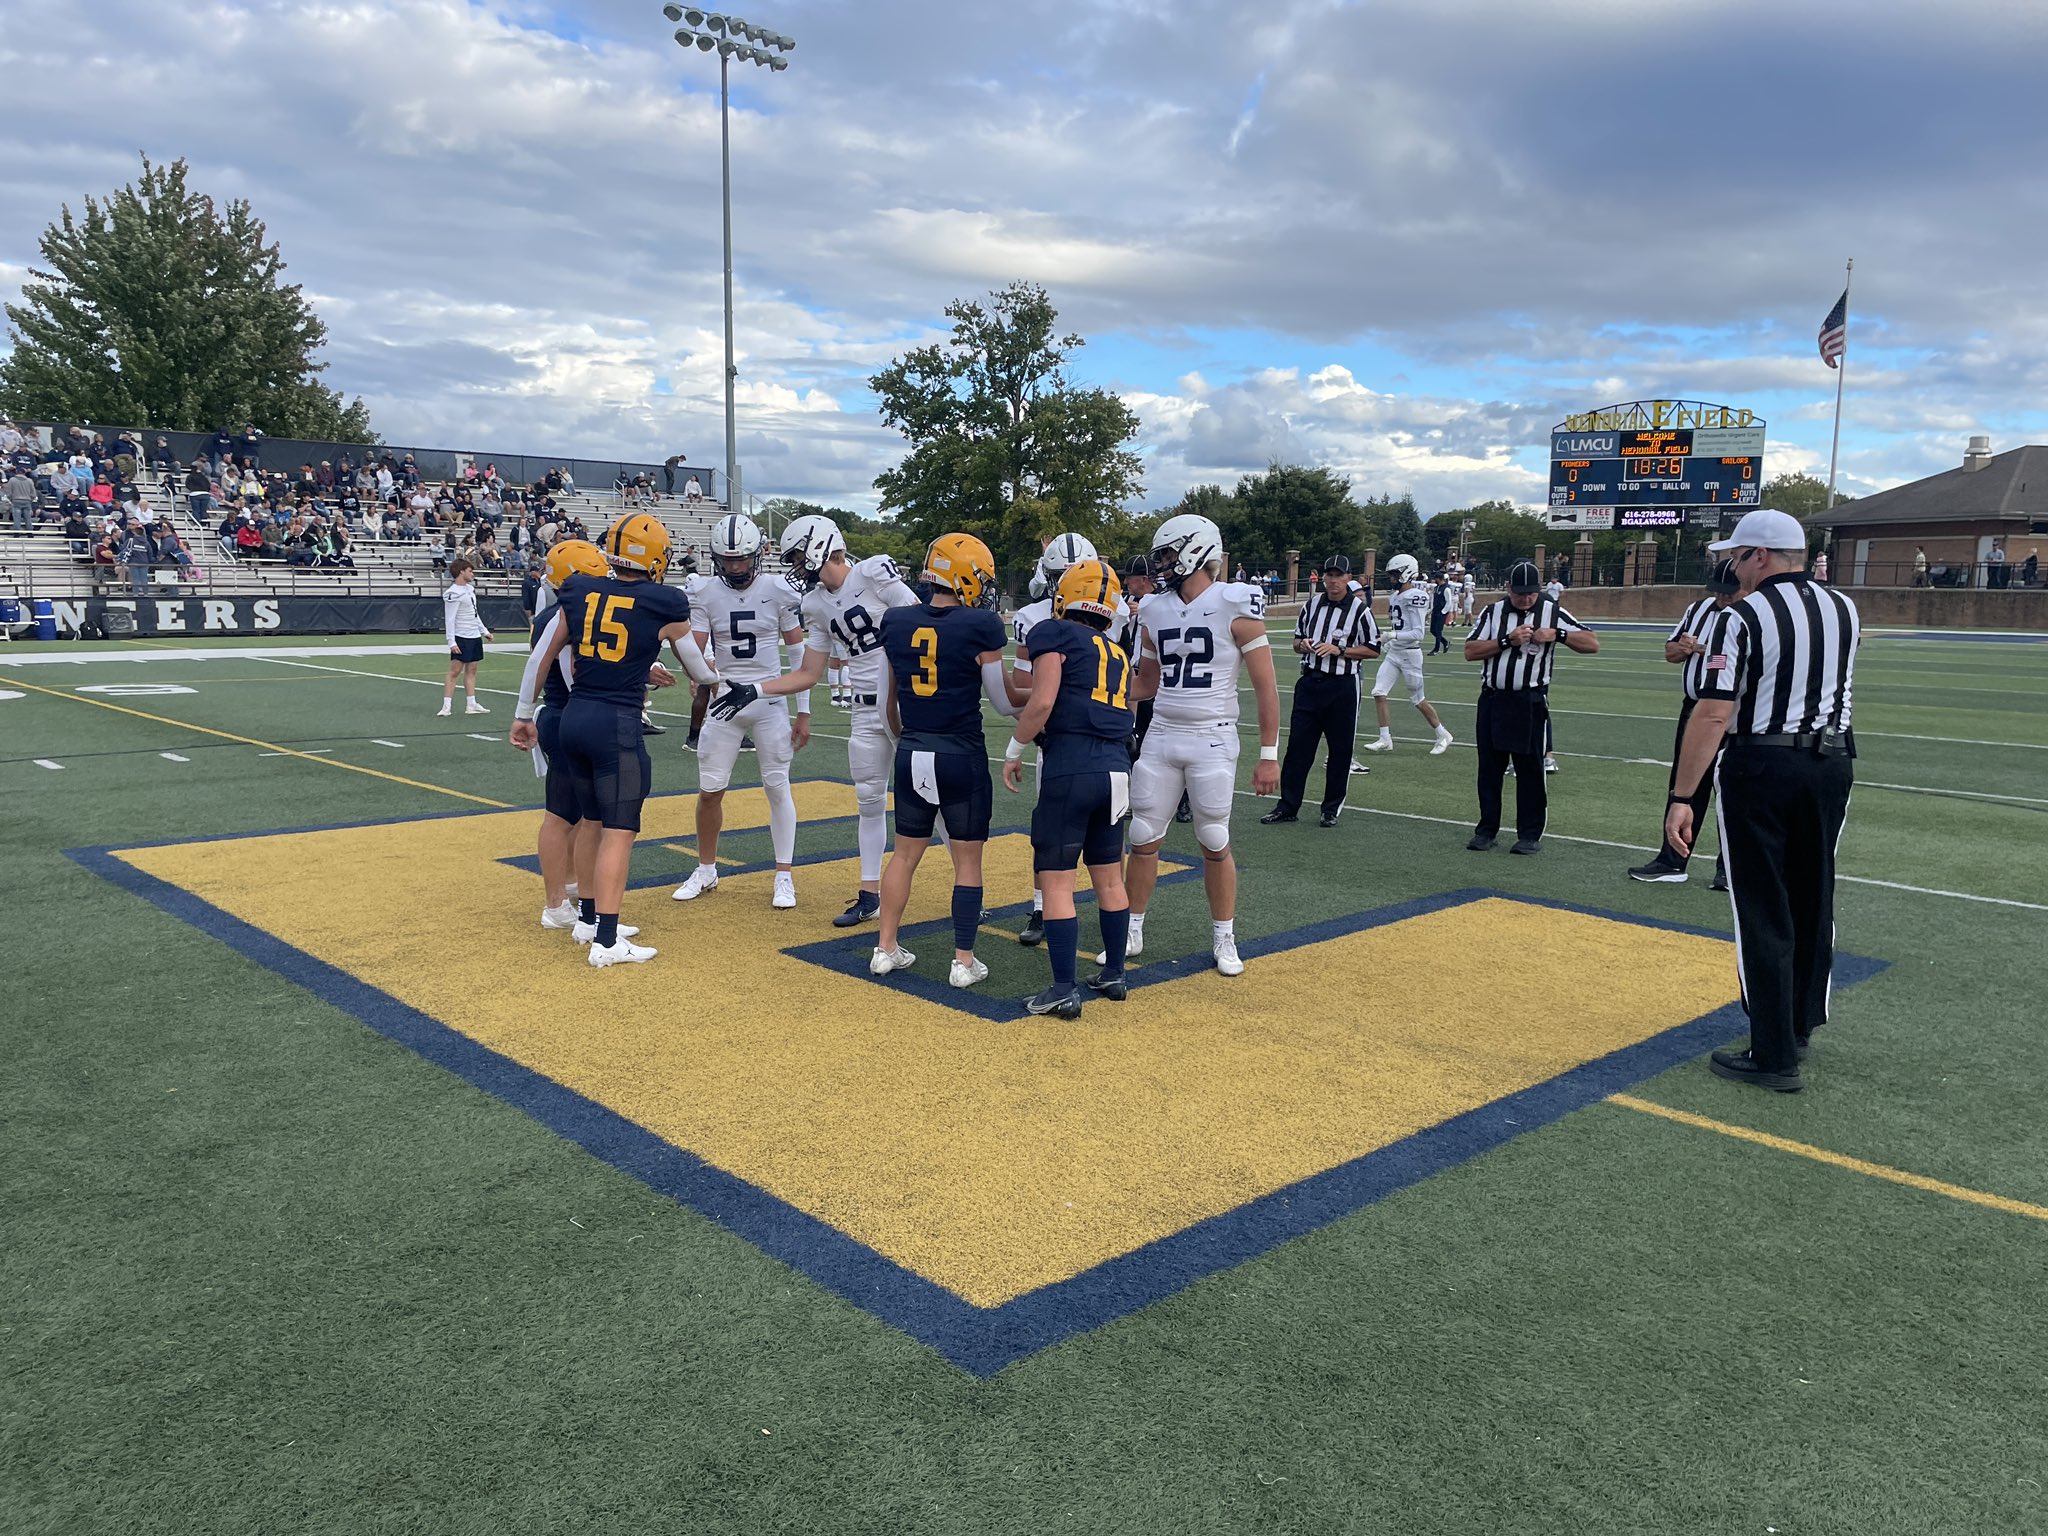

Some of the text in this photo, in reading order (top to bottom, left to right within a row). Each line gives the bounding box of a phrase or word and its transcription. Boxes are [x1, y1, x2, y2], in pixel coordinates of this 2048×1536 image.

[1678, 408, 1753, 427] FIELD
[1571, 438, 1613, 452] LMCU
[1664, 445, 1689, 454] FIELD
[1561, 460, 1590, 468] PIONEERS
[1634, 457, 1680, 475] 18:26
[1721, 457, 1749, 465] SAILORS
[1569, 469, 1578, 482] 0
[1742, 465, 1752, 479] 0
[1582, 483, 1606, 492] DOWN
[1617, 483, 1640, 491] TO GO
[1661, 482, 1690, 490] BALL ON
[1703, 481, 1720, 490] QTR
[1568, 490, 1575, 501] 3
[1731, 487, 1739, 499] 3
[1739, 489, 1757, 497] OUTS
[1586, 508, 1611, 516] FREE
[1621, 518, 1680, 526] BGALAW.COM
[1412, 595, 1428, 606] 23
[1081, 602, 1112, 617] Riddell
[579, 592, 635, 663] 15
[829, 604, 882, 657] 18
[1013, 620, 1024, 643] 11
[729, 610, 757, 659] 5
[911, 627, 938, 697] 3
[1158, 627, 1214, 688] 52
